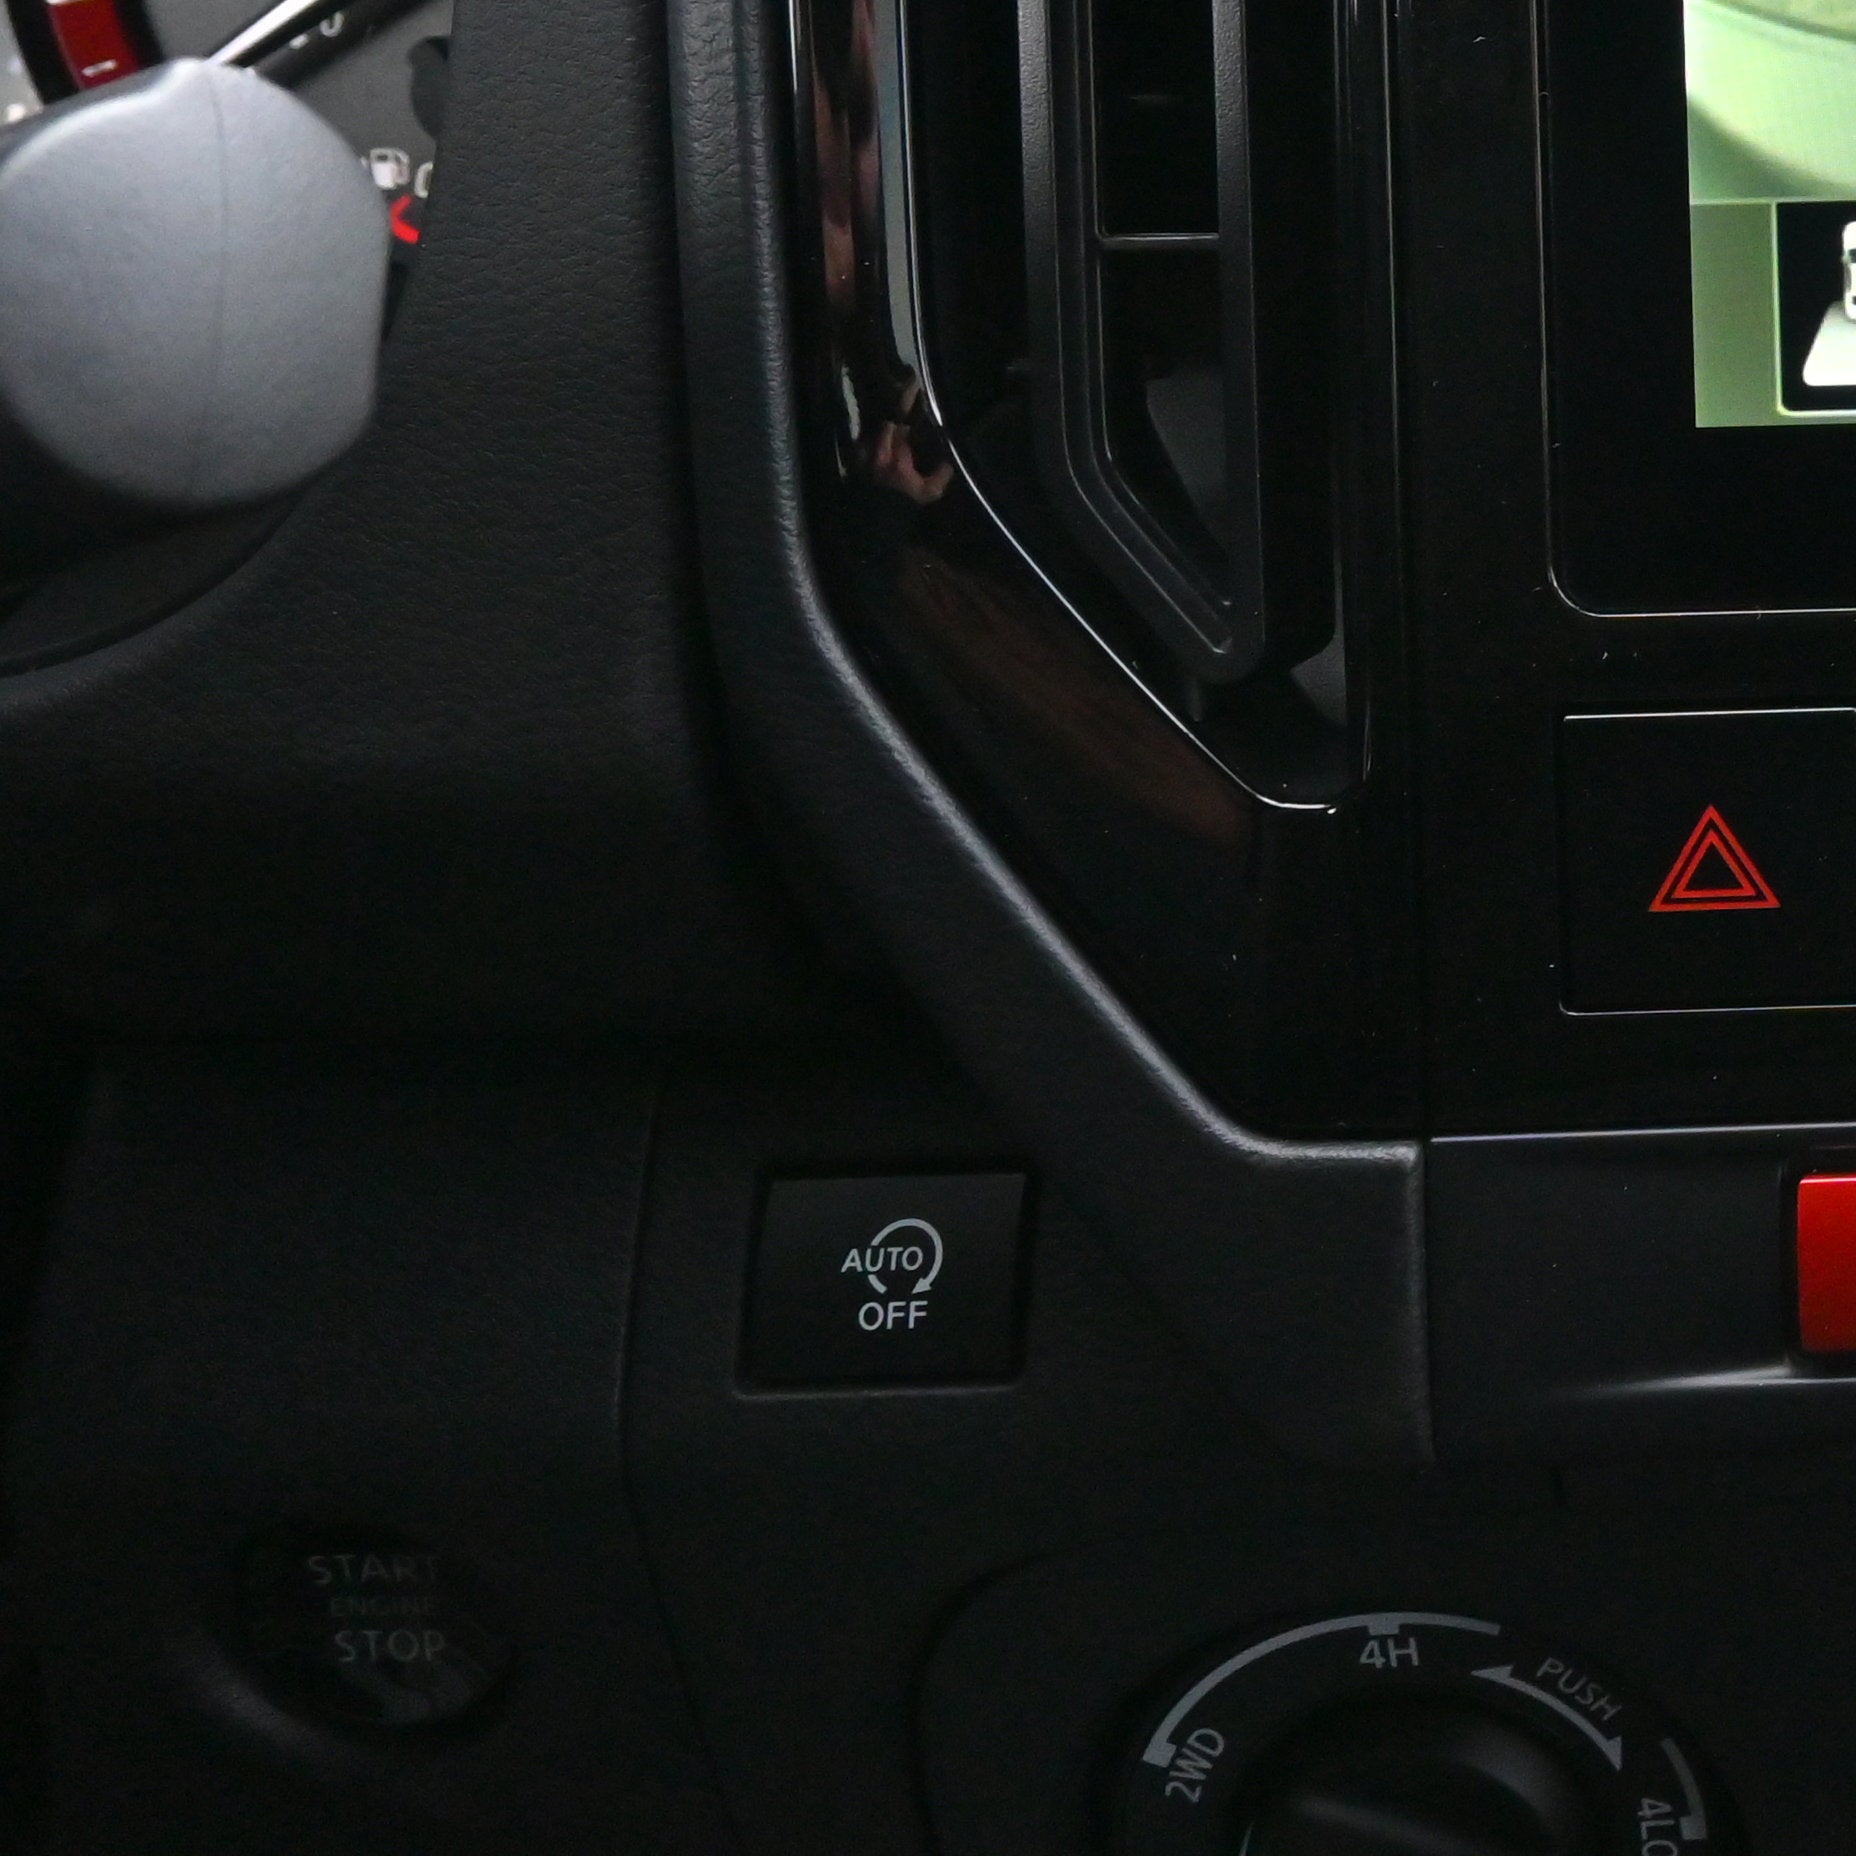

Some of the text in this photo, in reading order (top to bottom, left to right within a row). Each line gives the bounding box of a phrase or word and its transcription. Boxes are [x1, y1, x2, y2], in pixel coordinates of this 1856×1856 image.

[840, 1246, 924, 1273] AUTO
[858, 1300, 928, 1331] OFF
[307, 1552, 442, 1585] START
[334, 1628, 446, 1663] STOP
[1359, 1637, 1419, 1669] 4H
[1536, 1656, 1624, 1723] PUSH
[1164, 1727, 1226, 1805] 2WD
